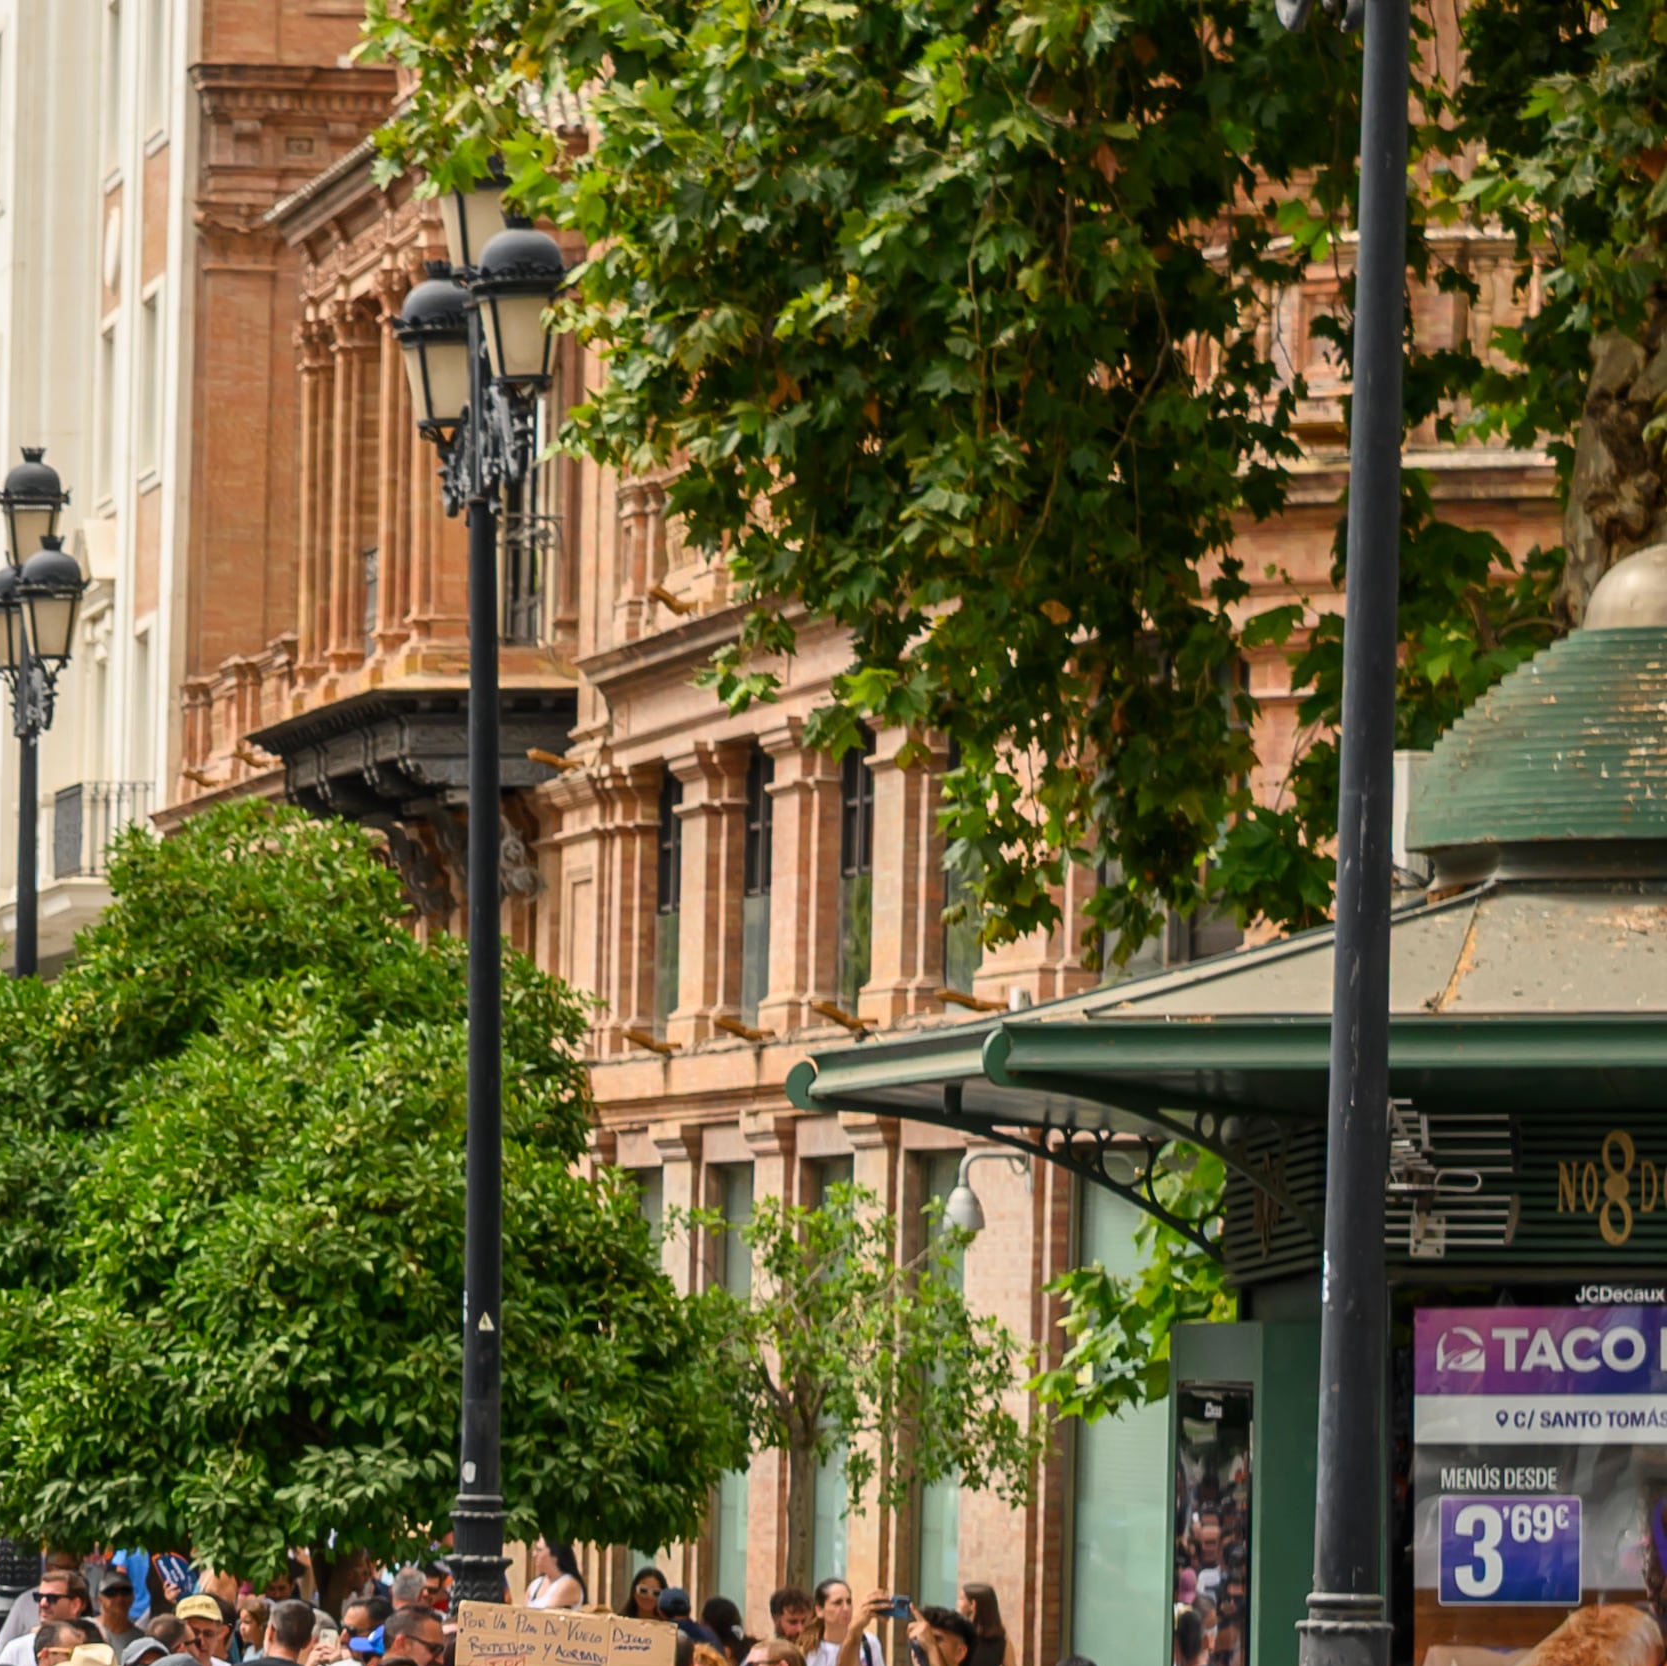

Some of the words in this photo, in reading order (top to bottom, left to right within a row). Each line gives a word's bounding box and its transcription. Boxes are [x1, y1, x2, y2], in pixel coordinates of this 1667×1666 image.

[1575, 1285, 1665, 1303] JCDecaux
[1492, 1326, 1646, 1373] TACO
[1514, 1409, 1535, 1429] C/
[1540, 1410, 1601, 1428] SANTO
[1440, 1463, 1501, 1490] MENÚS
[1504, 1467, 1557, 1490] DESDE
